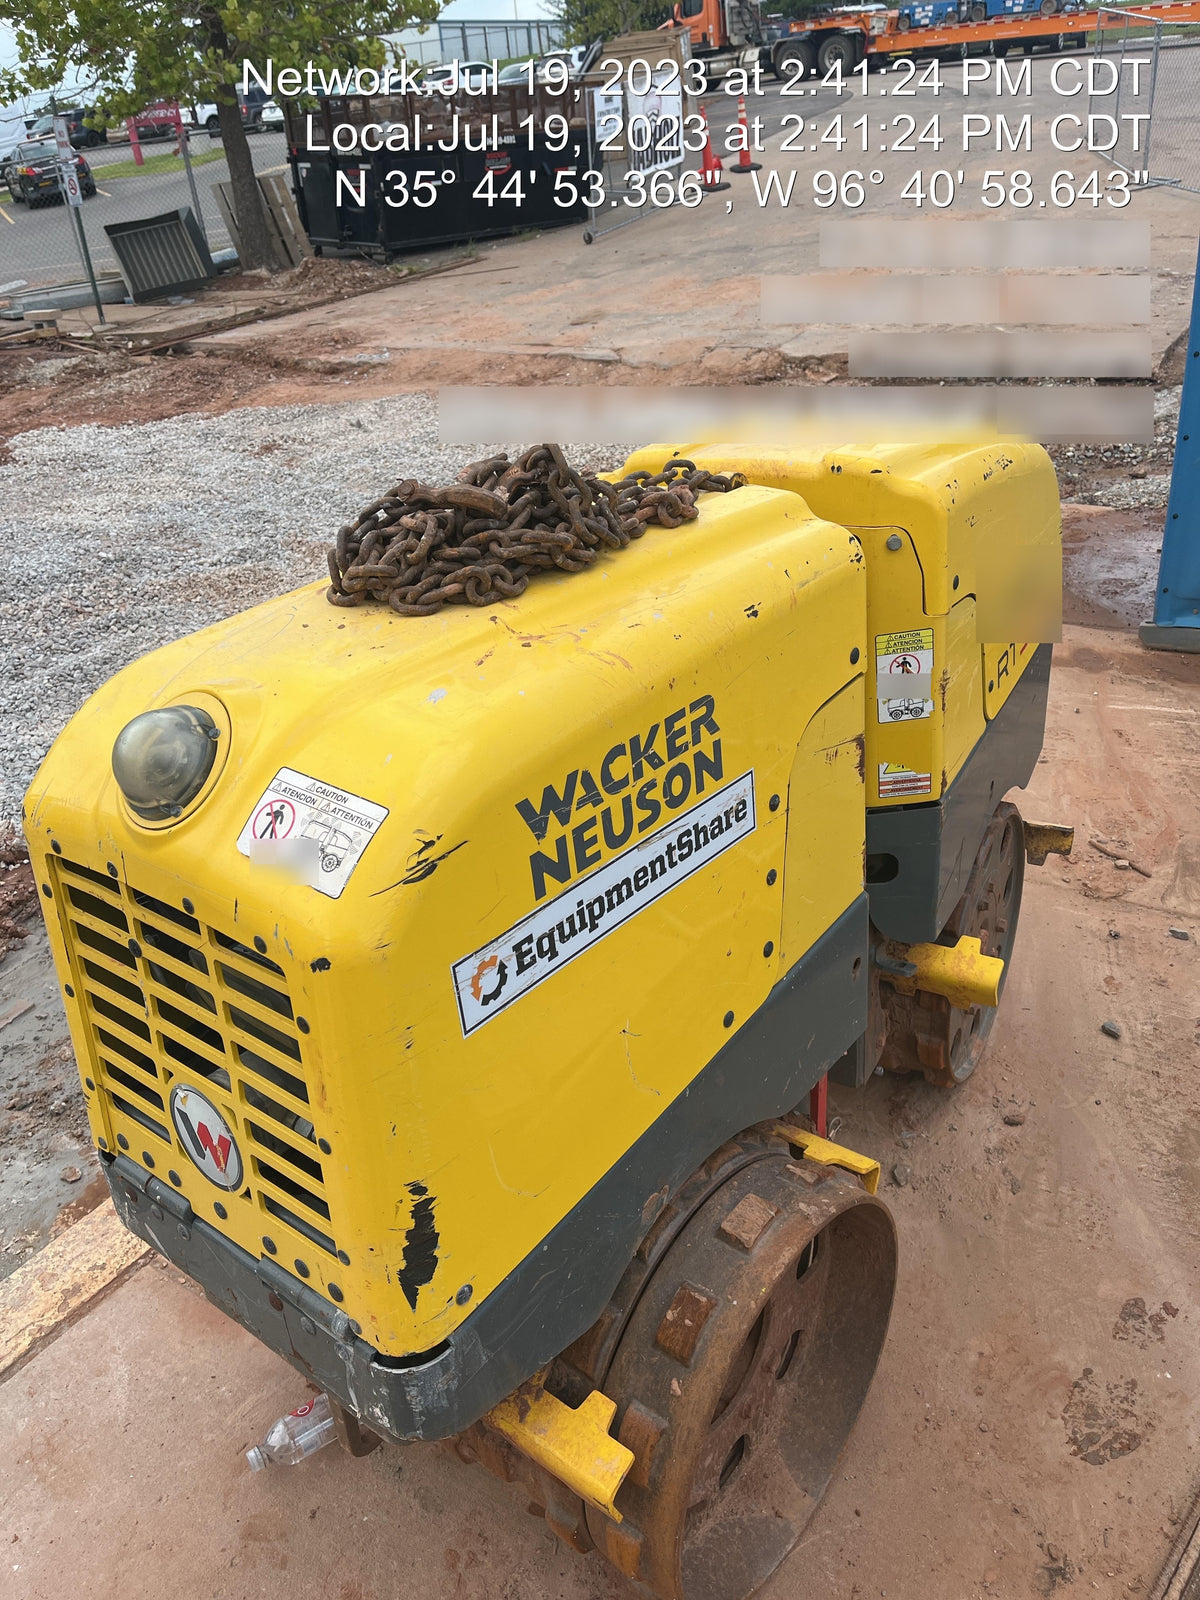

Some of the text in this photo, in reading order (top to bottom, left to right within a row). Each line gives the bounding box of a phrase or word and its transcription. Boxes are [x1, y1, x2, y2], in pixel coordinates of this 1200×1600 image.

[281, 786, 318, 806] ATENCION
[315, 786, 349, 804] CAUTION
[515, 694, 721, 846] WACKER
[529, 738, 724, 901] NEUSON
[511, 797, 749, 977] EquipmentShare
